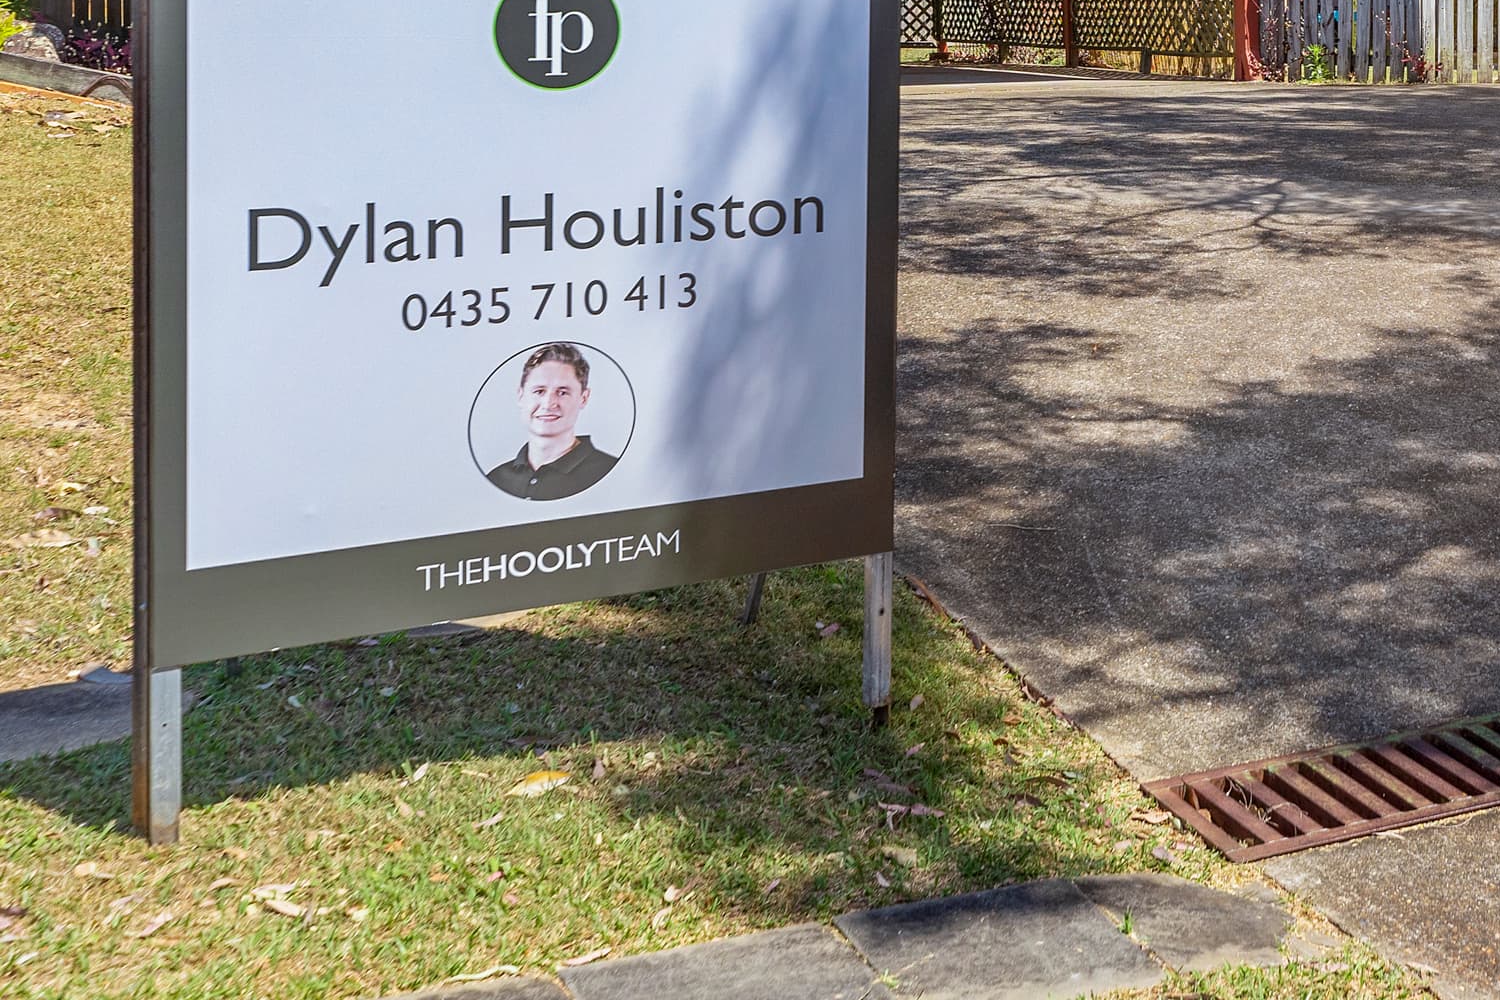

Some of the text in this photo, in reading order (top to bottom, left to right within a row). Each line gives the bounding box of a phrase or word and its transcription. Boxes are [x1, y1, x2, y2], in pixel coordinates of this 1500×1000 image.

[247, 186, 826, 288] Dylan Houliston
[401, 272, 698, 332] 0435 710 413
[415, 528, 681, 592] THEHOOLYTEAM
